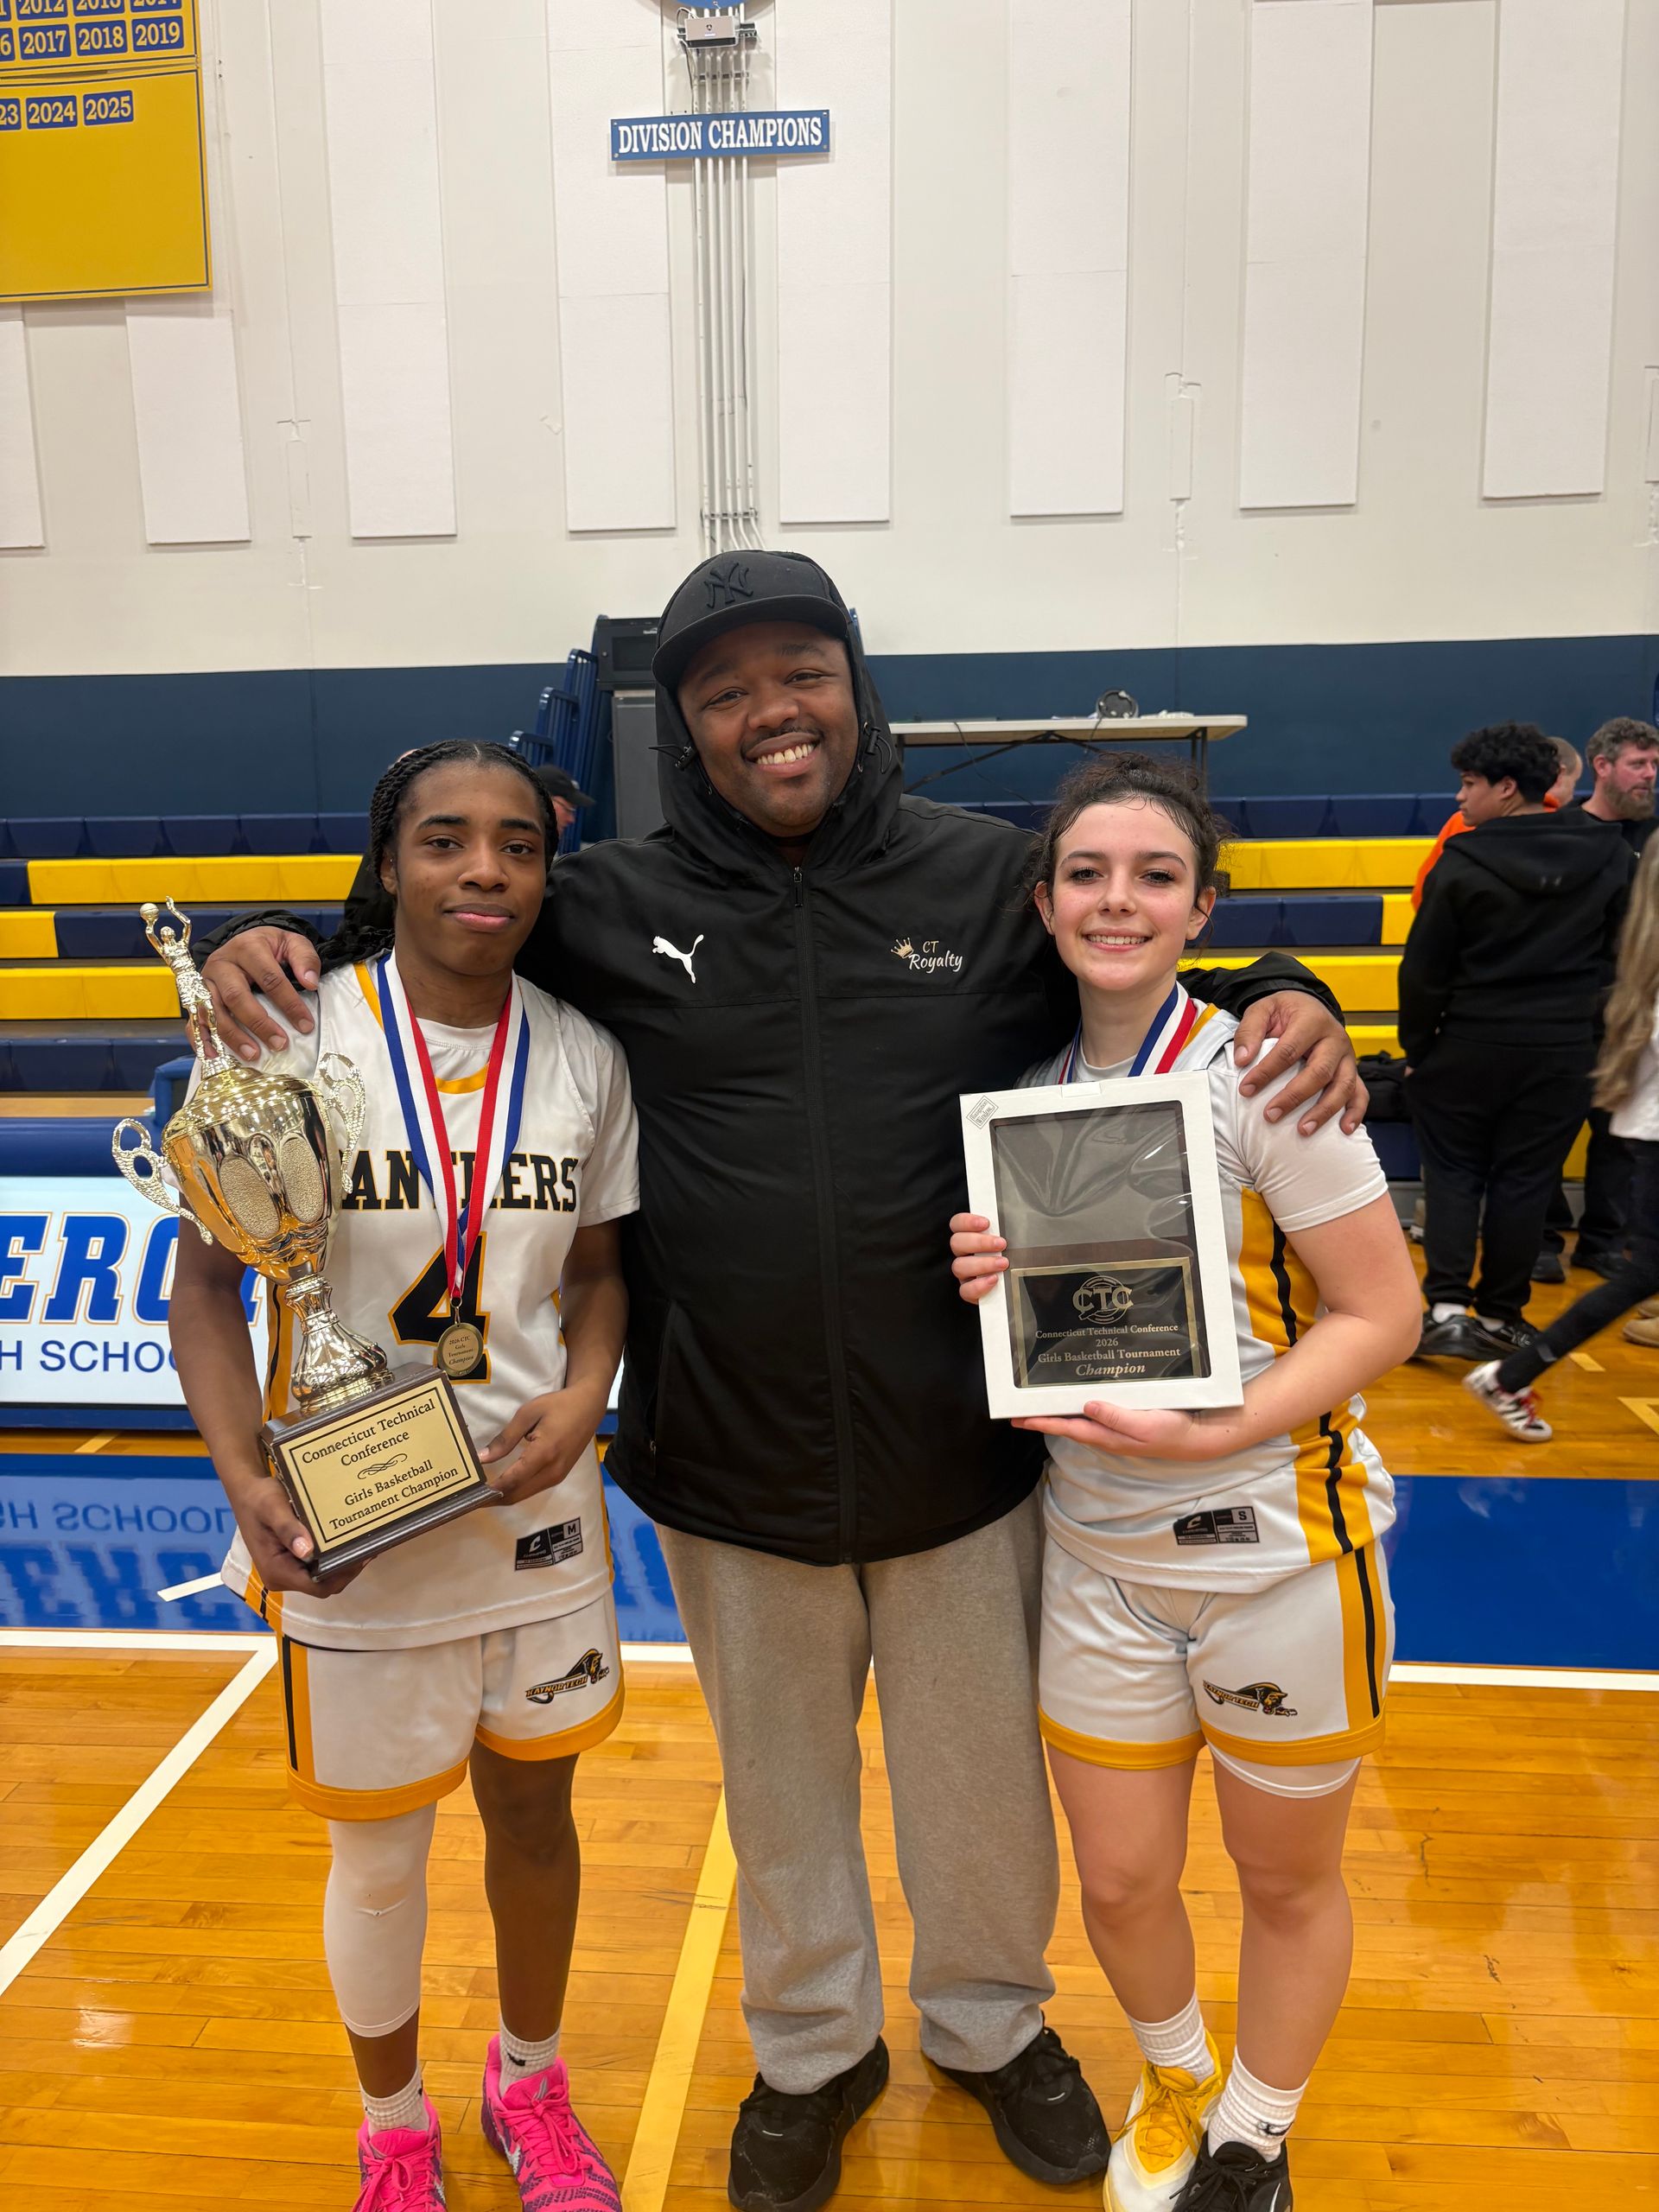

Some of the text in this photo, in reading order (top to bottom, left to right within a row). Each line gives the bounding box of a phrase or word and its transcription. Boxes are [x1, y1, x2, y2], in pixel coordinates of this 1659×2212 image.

[22, 30, 67, 54] 2017
[79, 26, 124, 50] 2018
[135, 22, 181, 46] 2019
[28, 101, 75, 124] 2024
[86, 96, 131, 120] 2025
[618, 117, 823, 154] DIVISION CHAMPIONS
[922, 940, 939, 953] CT
[908, 950, 963, 974] Royalty
[389, 1231, 491, 1384] 4
[1073, 1287, 1134, 1312] CTC
[1035, 1324, 1179, 1338] Connecticut Technical Conference
[1096, 1338, 1119, 1347] 2026
[1038, 1347, 1181, 1363] Girls Basketball Tournament
[1076, 1363, 1146, 1378] Champion
[302, 1399, 435, 1464] Connecticut Technical
[340, 1431, 410, 1466] Conference
[344, 1459, 434, 1506] Girls Basketball
[329, 1467, 459, 1530] Tournament Champion
[1238, 1510, 1248, 1521] S
[568, 1523, 576, 1535] M
